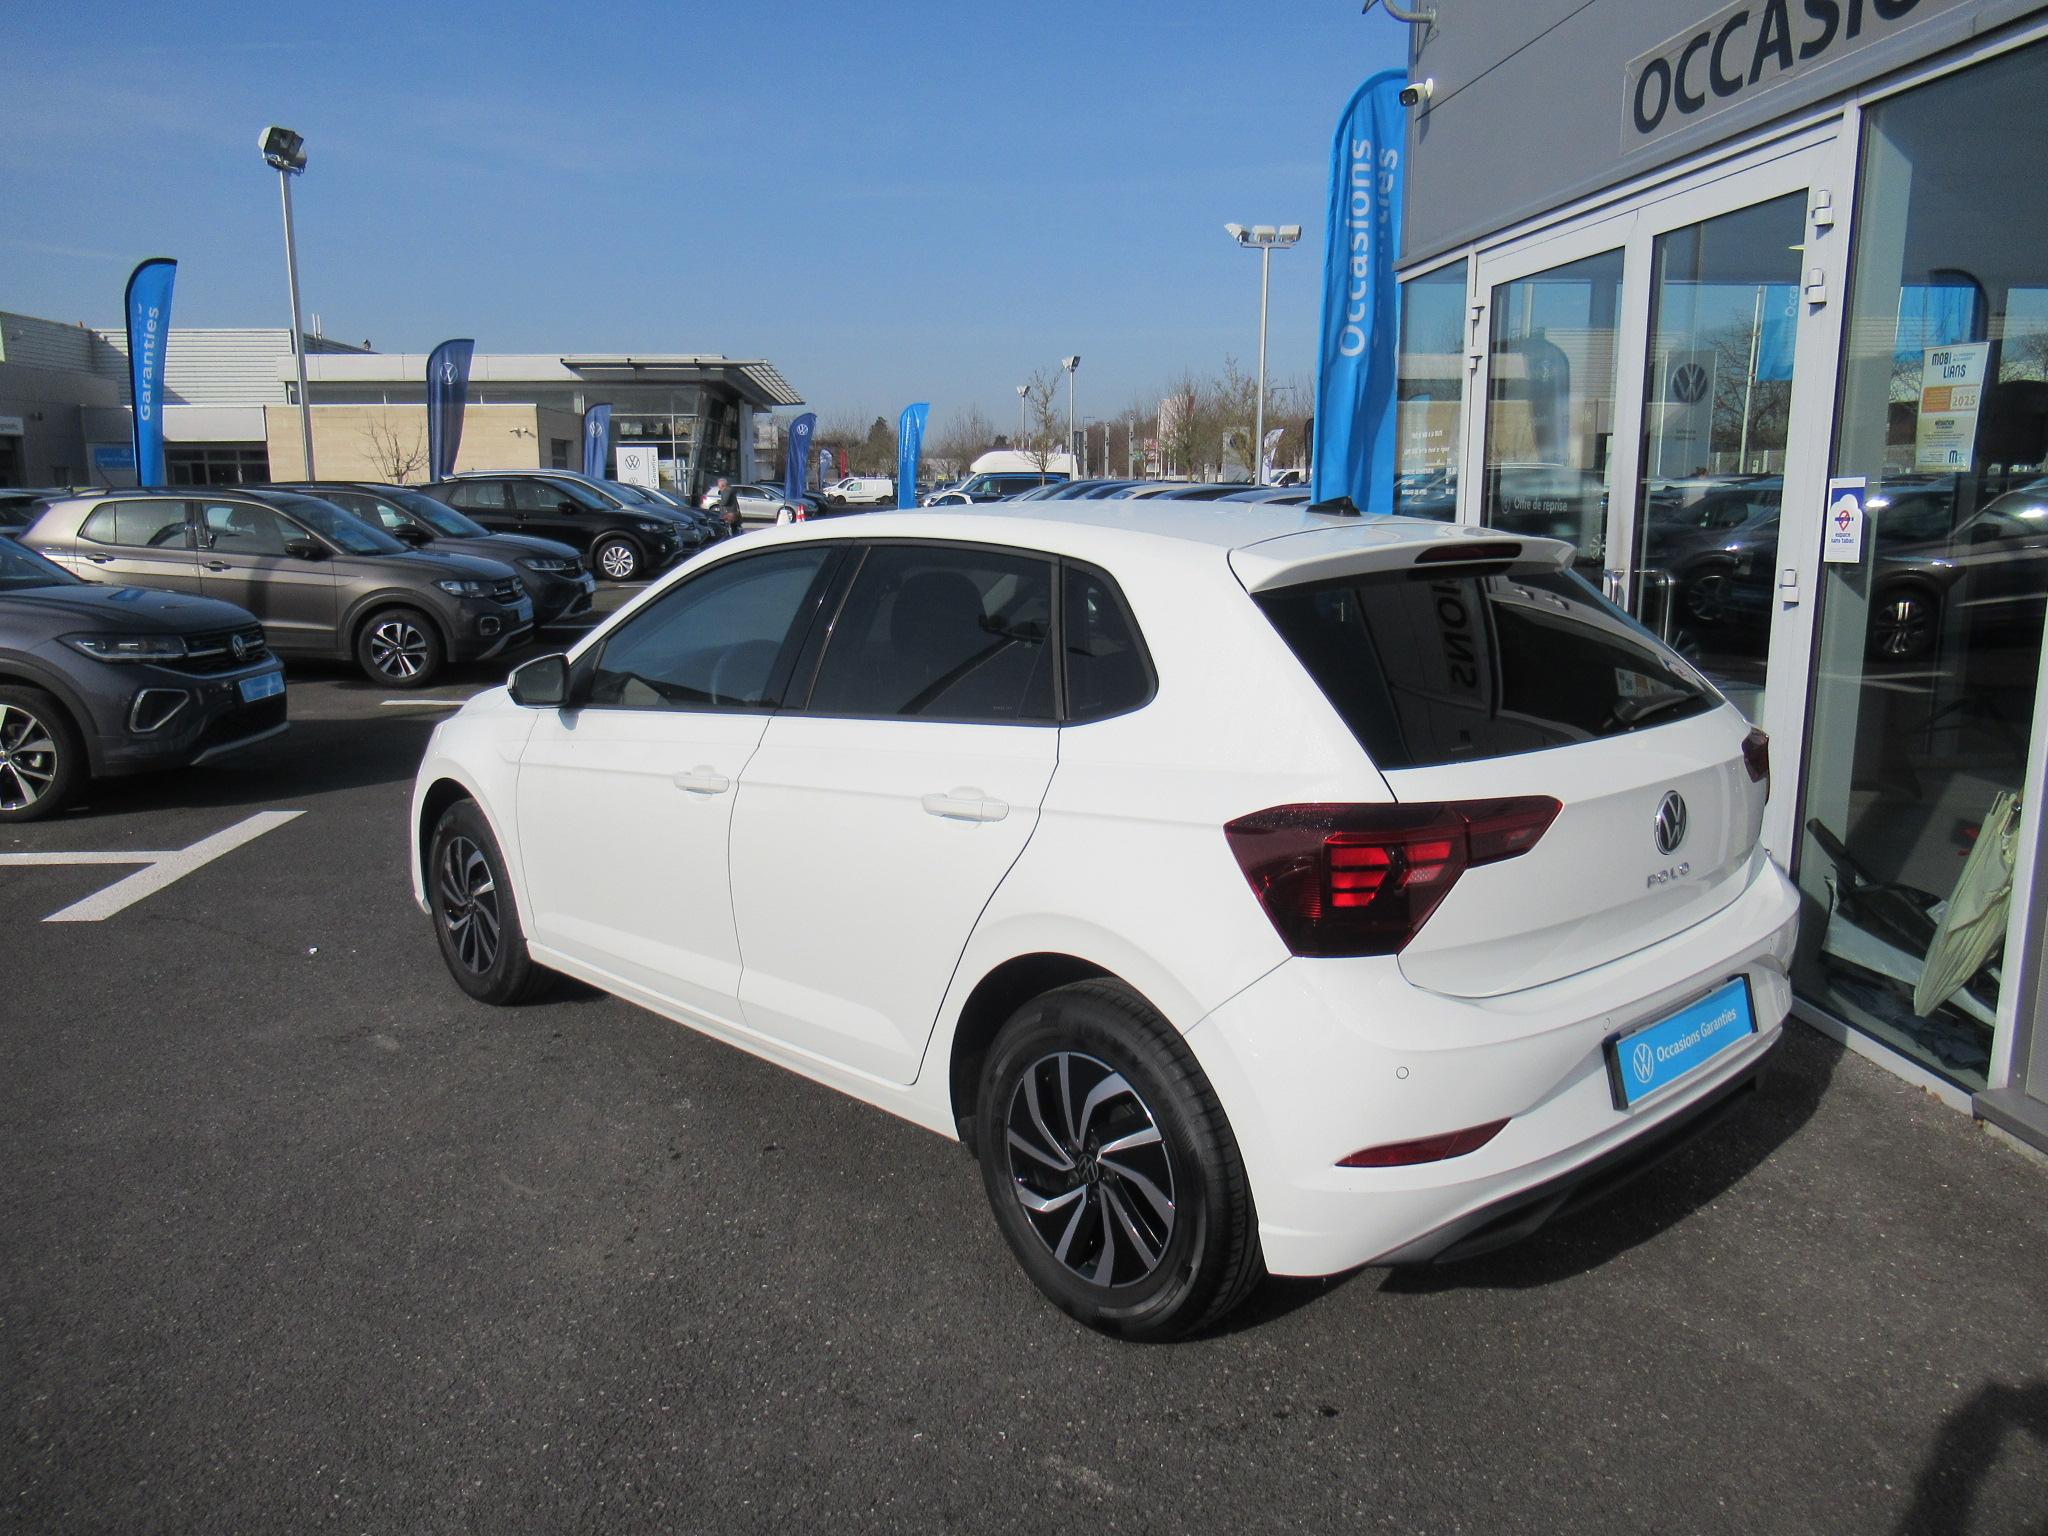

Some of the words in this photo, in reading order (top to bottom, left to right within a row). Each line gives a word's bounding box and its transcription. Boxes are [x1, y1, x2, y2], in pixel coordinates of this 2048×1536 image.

[1633, 0, 1924, 134] OCCASI
[1339, 138, 1372, 357] Occasions
[140, 306, 159, 421] Garanties
[1932, 352, 1951, 366] MOBI
[1943, 364, 1966, 378] LIANS
[1953, 396, 1976, 406] 2025
[625, 455, 640, 470] VW
[1533, 498, 1541, 510] de
[1654, 790, 1687, 855] VW
[1647, 862, 1690, 889] POLO
[1633, 1043, 1654, 1083] VW
[1656, 1031, 1700, 1062] Occasions
[1700, 1008, 1737, 1038] Garanties
